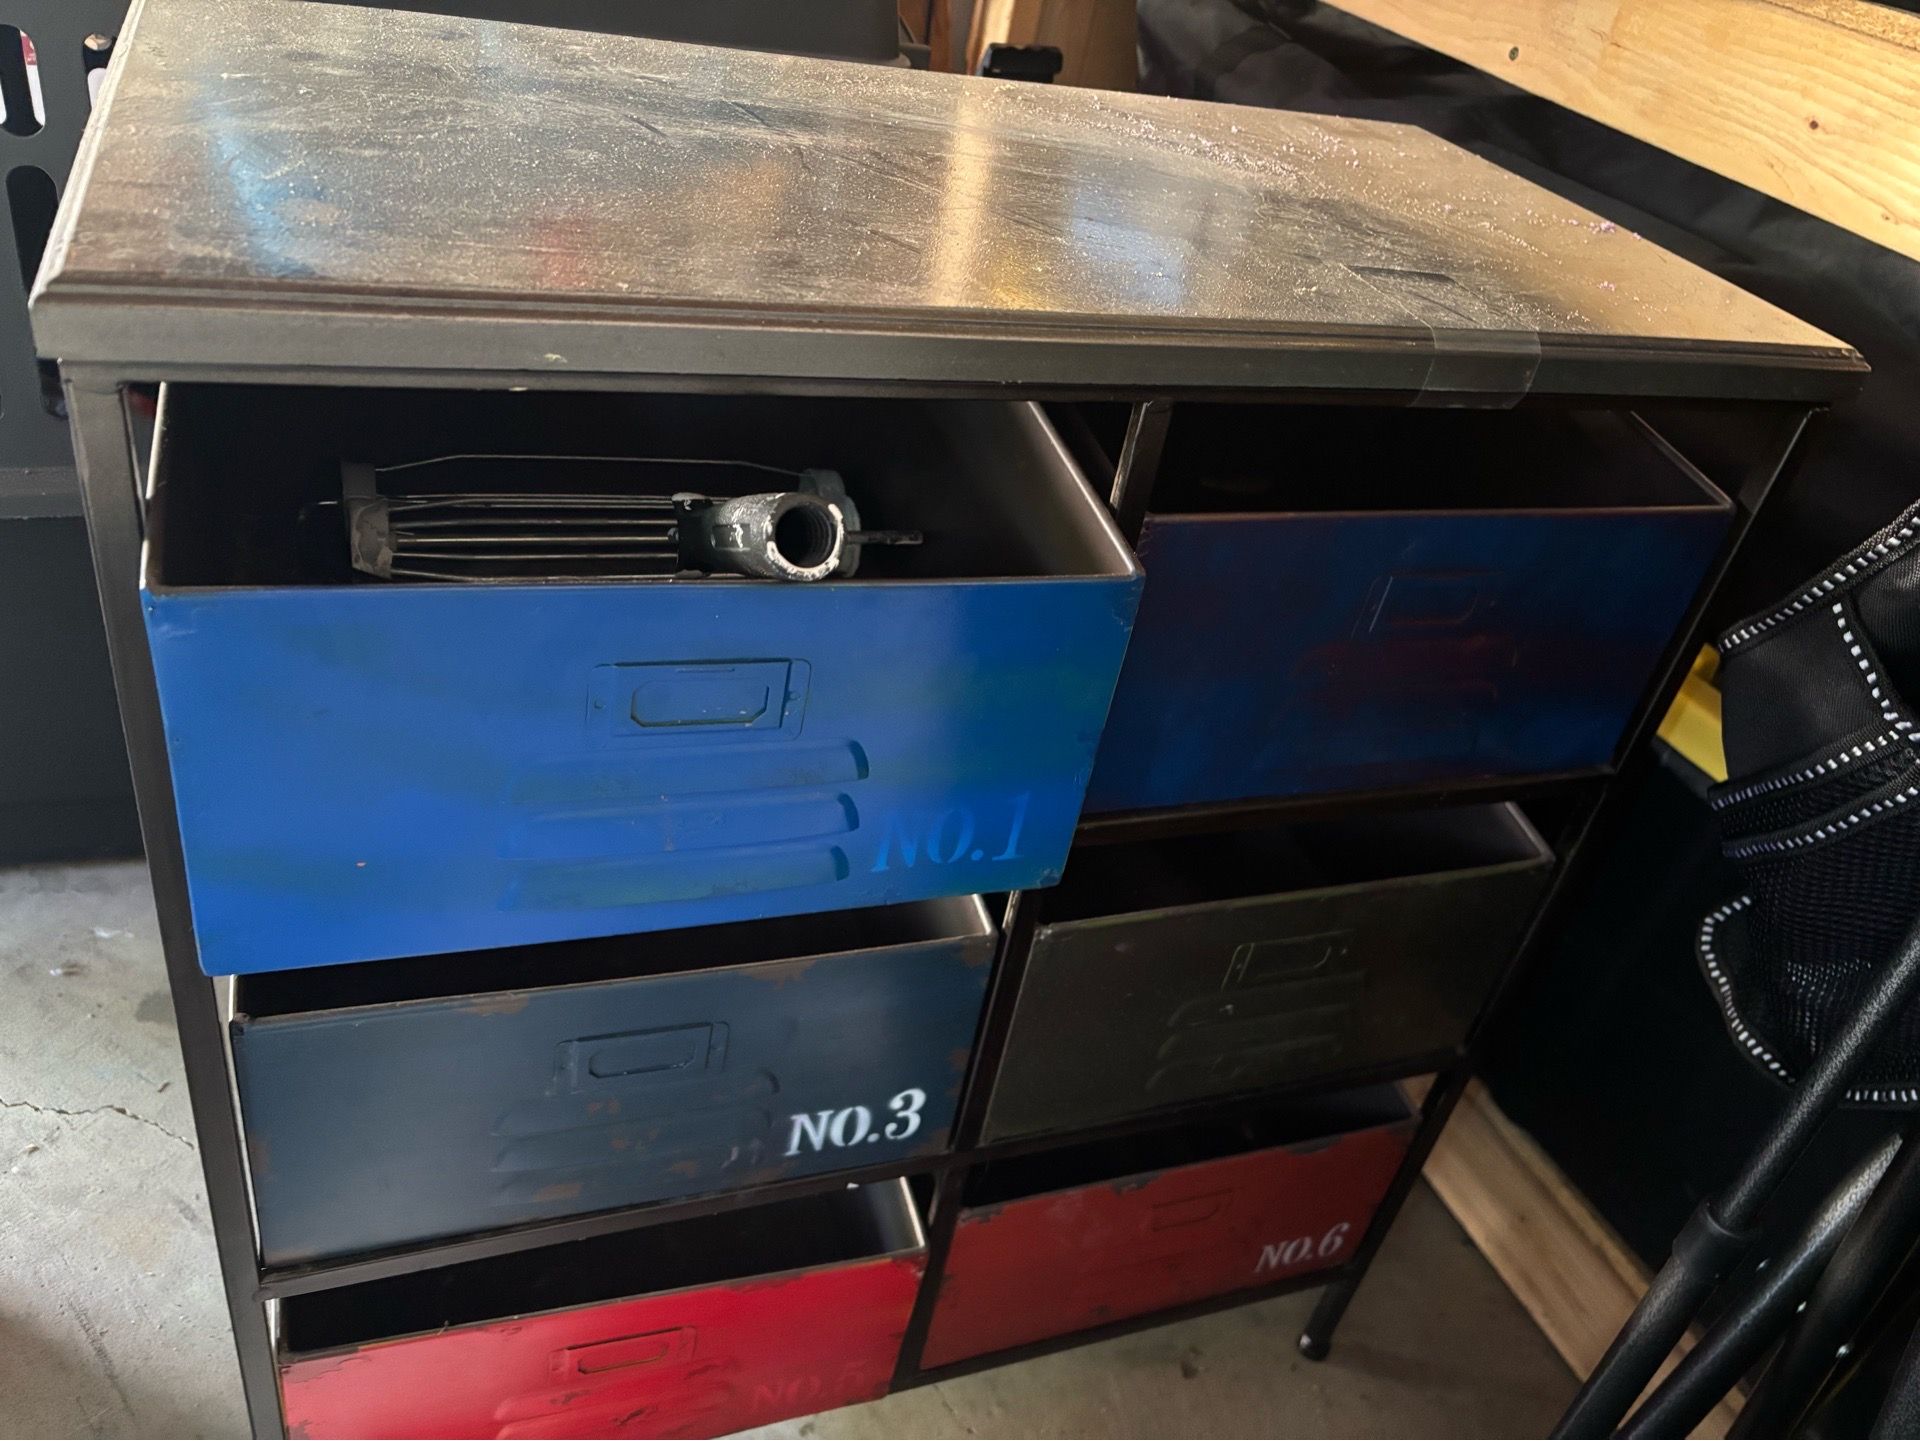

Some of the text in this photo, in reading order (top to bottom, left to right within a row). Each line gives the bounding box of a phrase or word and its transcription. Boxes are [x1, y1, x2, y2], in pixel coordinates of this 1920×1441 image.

[870, 791, 1031, 873] NO.1
[783, 1088, 927, 1157] NO.3
[1254, 1222, 1350, 1273] NO.6
